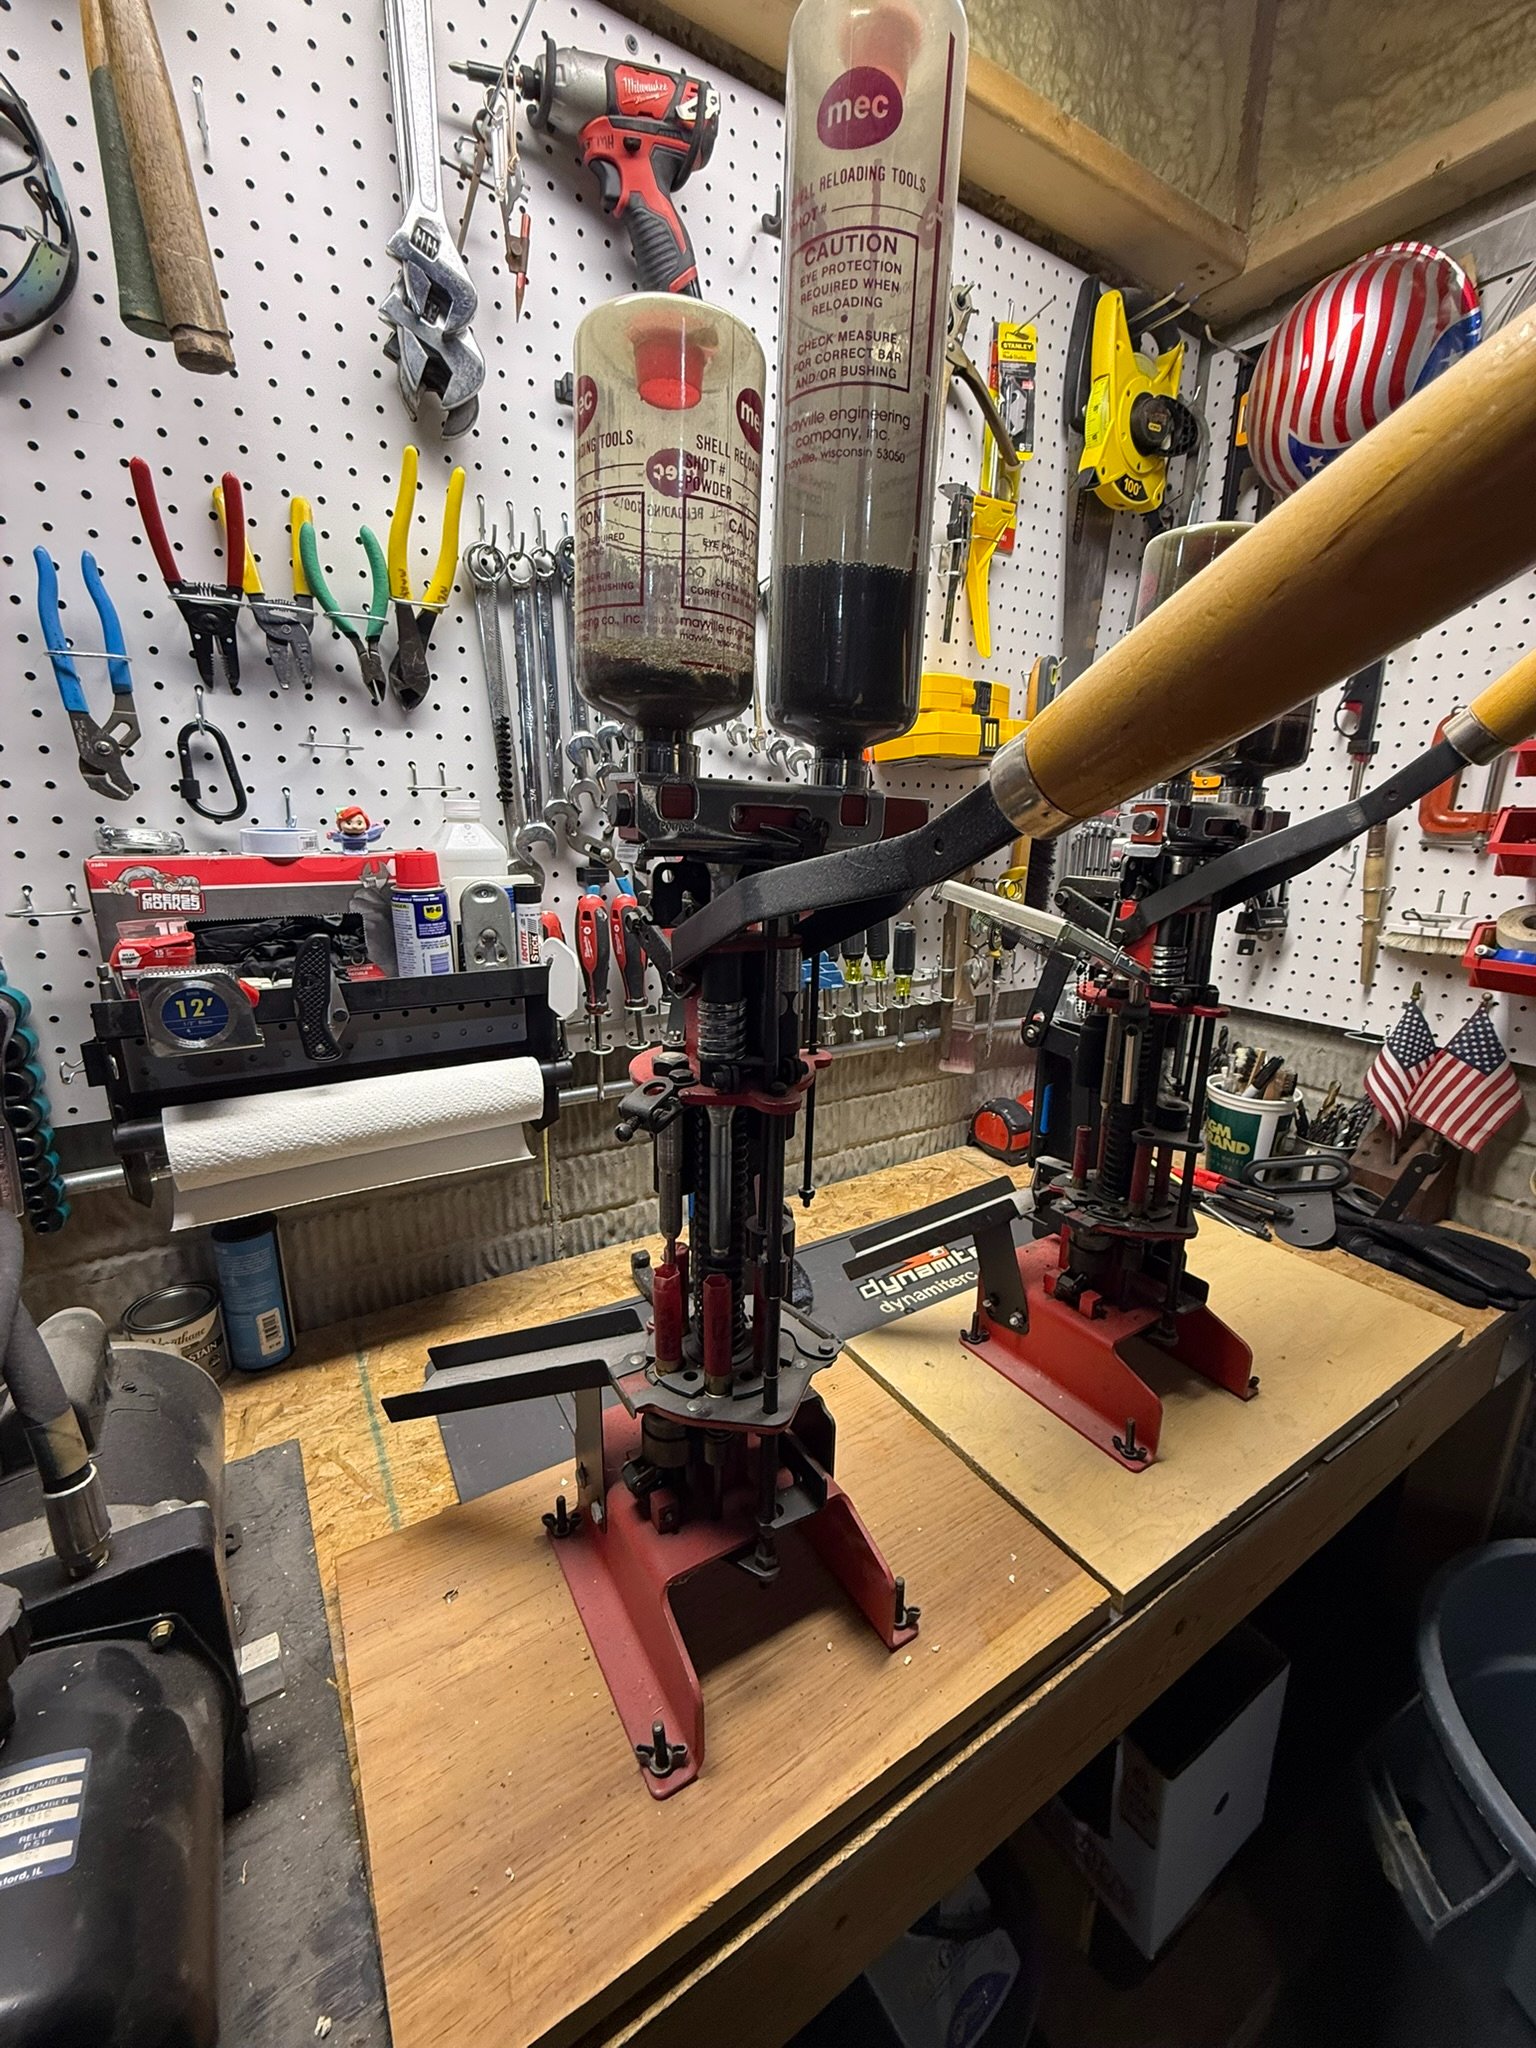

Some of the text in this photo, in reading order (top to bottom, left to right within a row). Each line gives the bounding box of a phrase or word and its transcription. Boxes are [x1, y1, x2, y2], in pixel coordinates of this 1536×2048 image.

[621, 77, 669, 95] Milwaukee
[826, 94, 889, 128] mec
[819, 166, 886, 192] RELOADING
[892, 167, 927, 194] TOOLS
[804, 233, 898, 267] CAUTION
[800, 259, 902, 289] EYE PROTECTION
[800, 278, 900, 305] REQUIRED WHEN
[811, 296, 883, 317] RELOADING
[797, 330, 898, 356] CHECK MEASURE
[1002, 342, 1033, 350] STANLEY
[793, 347, 902, 376] FOR CORRECT BAR
[795, 365, 897, 390] AND/OR BUSHING
[829, 405, 911, 430] engineering
[600, 429, 634, 449] TOOLS
[696, 434, 731, 458] SHELL
[795, 425, 891, 448] company, inc.
[685, 453, 717, 476] SHOT
[820, 446, 873, 460] wisconsin
[876, 446, 906, 464] 53050
[685, 477, 732, 500] POWDER
[597, 581, 635, 593] BUSHING
[680, 616, 725, 633] mayville
[141, 893, 200, 902] GREASE
[520, 930, 529, 963] LOCTITE
[530, 934, 539, 963] STICK
[175, 997, 214, 1019] 12'
[1205, 1119, 1231, 1140] GM
[1206, 1130, 1251, 1156] RAND
[188, 1340, 218, 1361] STAIN
[23, 1776, 69, 1792] NUMBER
[24, 1798, 70, 1814] NUMBER
[18, 1827, 55, 1845] RELIEF
[23, 1839, 47, 1851] PSI
[31, 1866, 43, 1877] IL
